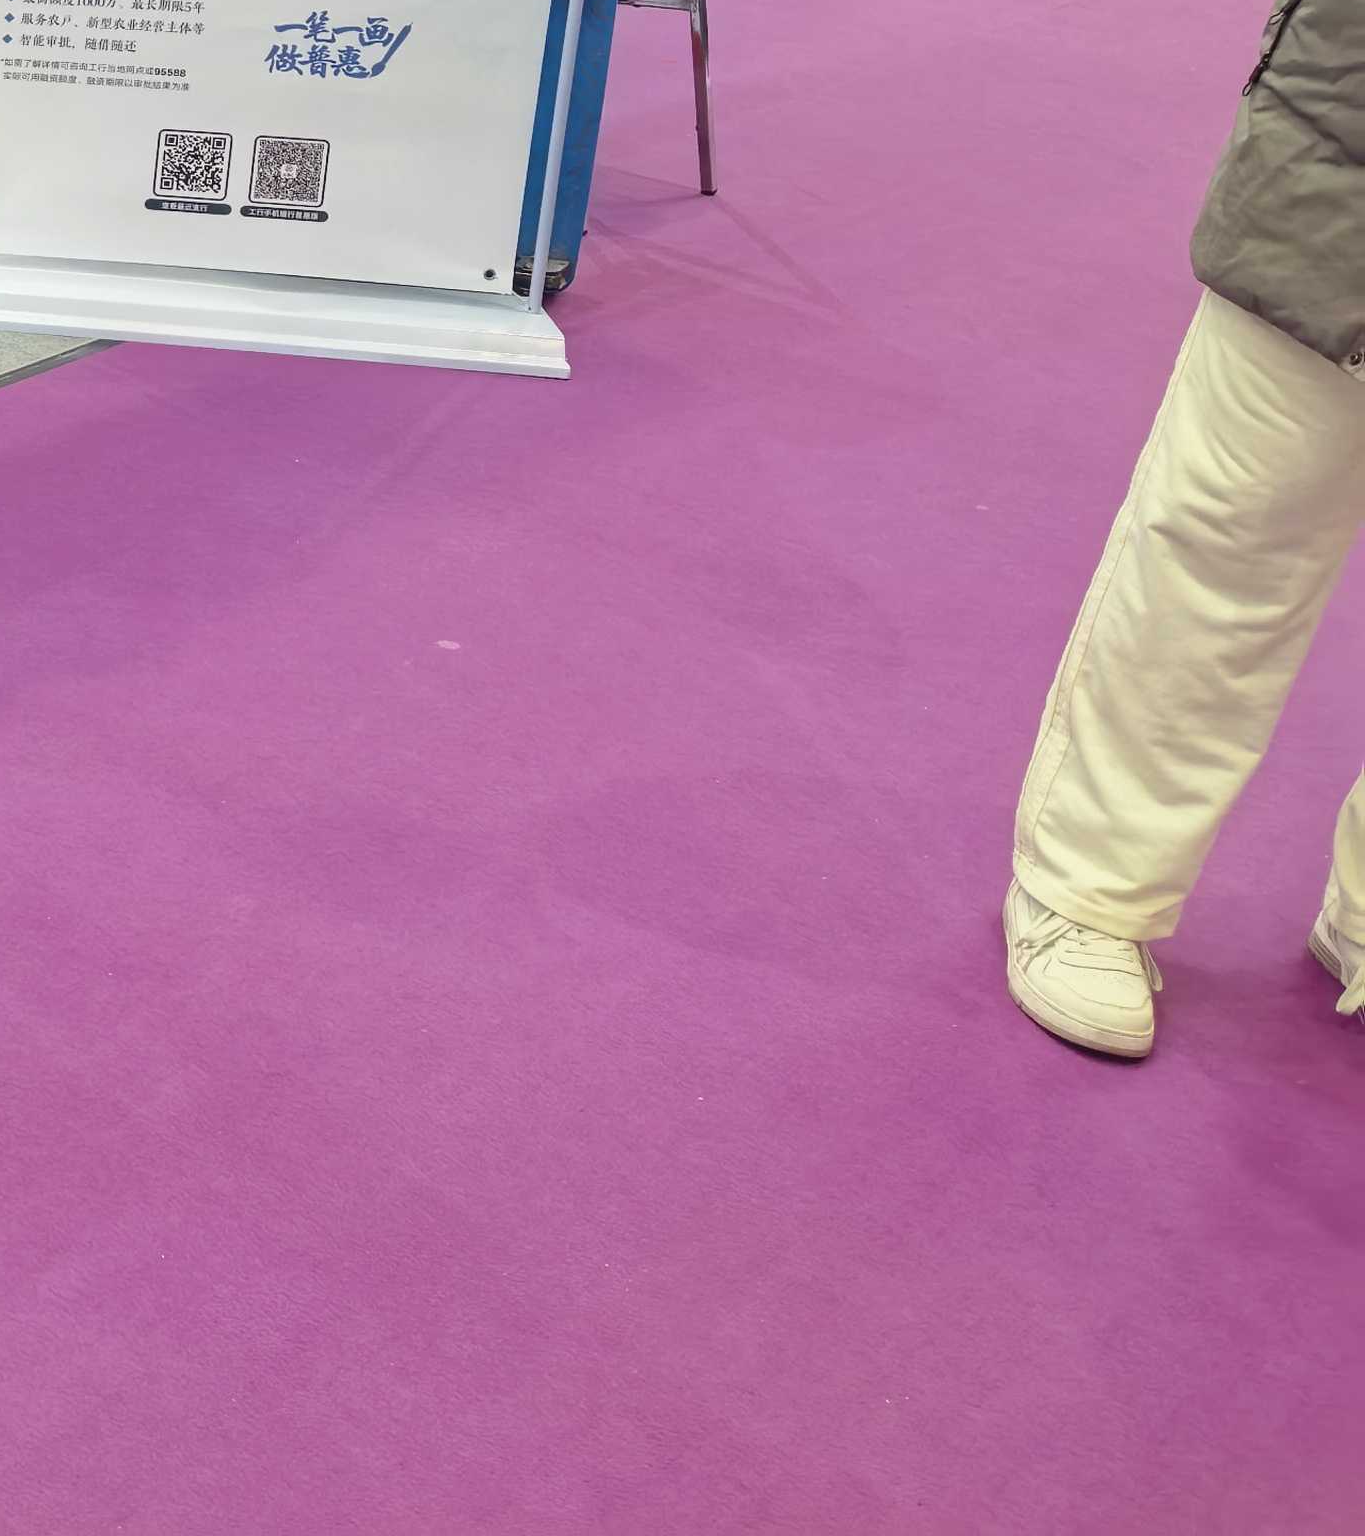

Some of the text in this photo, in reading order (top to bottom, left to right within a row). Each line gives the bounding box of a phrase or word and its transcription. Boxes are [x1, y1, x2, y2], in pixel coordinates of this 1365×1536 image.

[273, 10, 396, 45] 一笔一画
[264, 43, 386, 78] 做普惠
